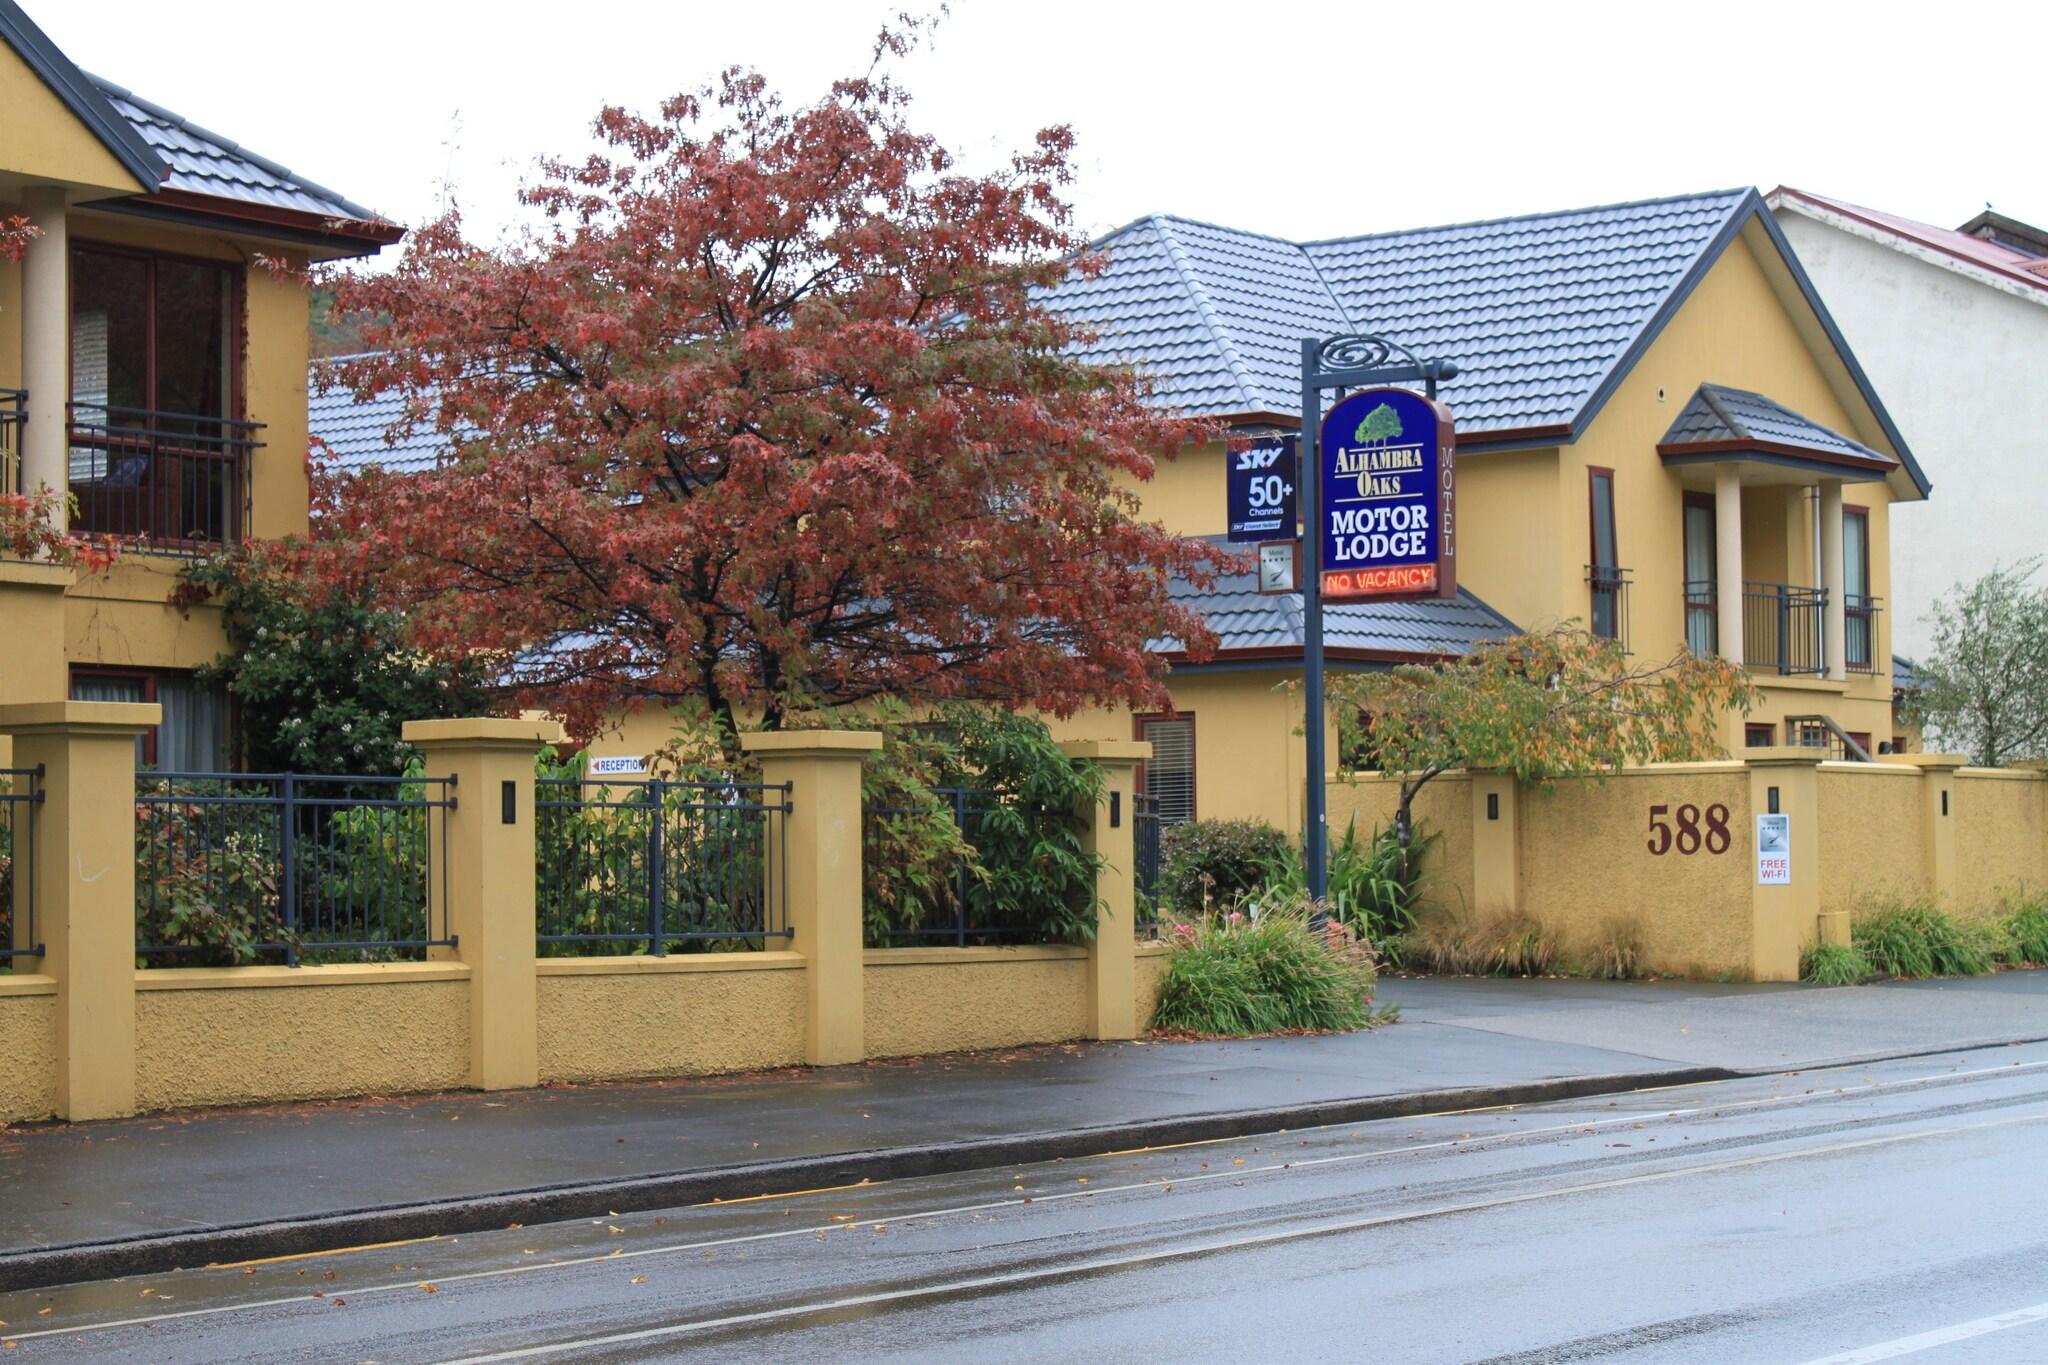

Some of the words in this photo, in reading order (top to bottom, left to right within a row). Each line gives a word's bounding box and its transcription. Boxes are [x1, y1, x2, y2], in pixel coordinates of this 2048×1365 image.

[1236, 447, 1284, 470] SKY
[1335, 447, 1423, 473] ALHAMBRA
[1248, 475, 1293, 507] 50+
[1357, 471, 1400, 497] OAKS
[1249, 507, 1284, 517] Channels
[1442, 447, 1454, 557] MOTEL
[1331, 505, 1429, 535] MOTOR
[1335, 532, 1426, 560] LODGE
[1325, 575, 1350, 591] NO
[1356, 569, 1431, 588] VACANCY
[601, 760, 645, 770] RECEPTION
[1647, 803, 1731, 856] 588
[1760, 860, 1787, 868] FREE
[1761, 869, 1786, 878] WI-FI
